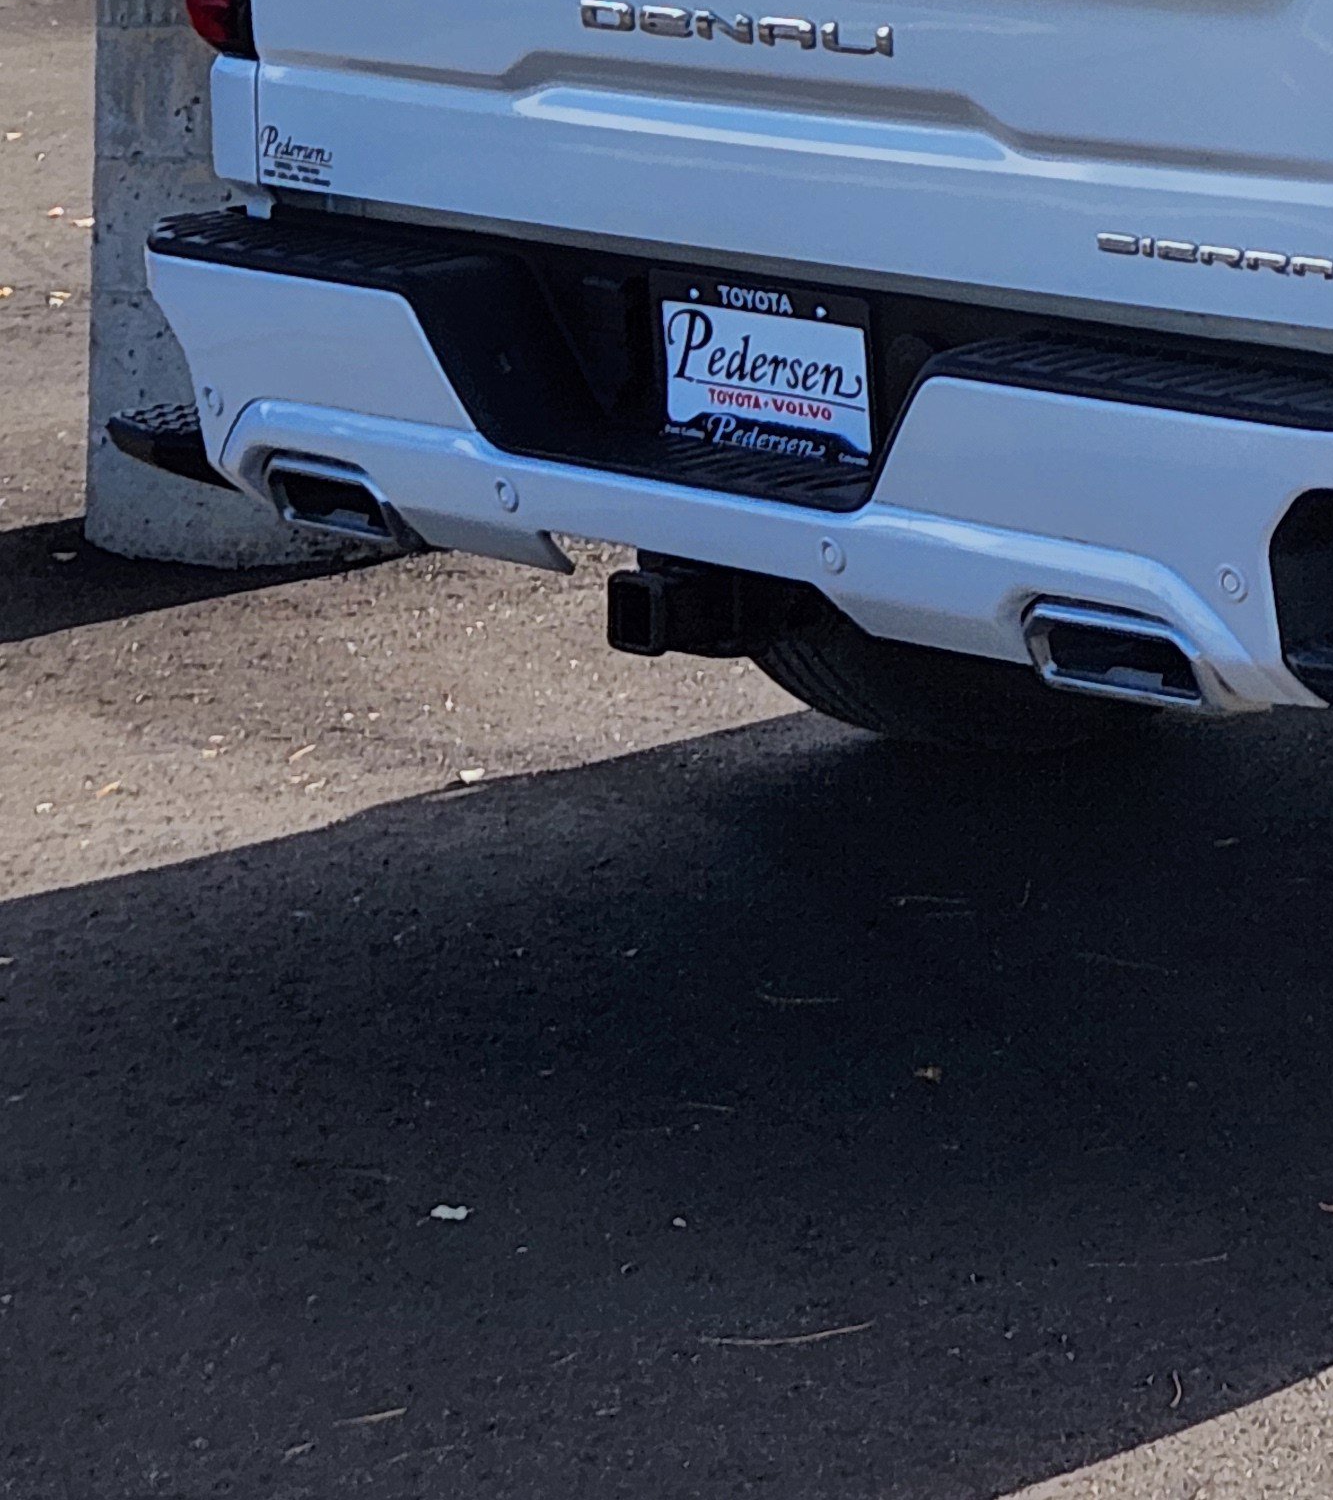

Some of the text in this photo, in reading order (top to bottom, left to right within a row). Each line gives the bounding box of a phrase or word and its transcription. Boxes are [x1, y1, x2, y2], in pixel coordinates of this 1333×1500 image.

[579, 0, 895, 58] DENALI
[717, 285, 794, 315] TOYOTA
[667, 308, 863, 399] Pedersen
[706, 414, 825, 459] Pedersen
